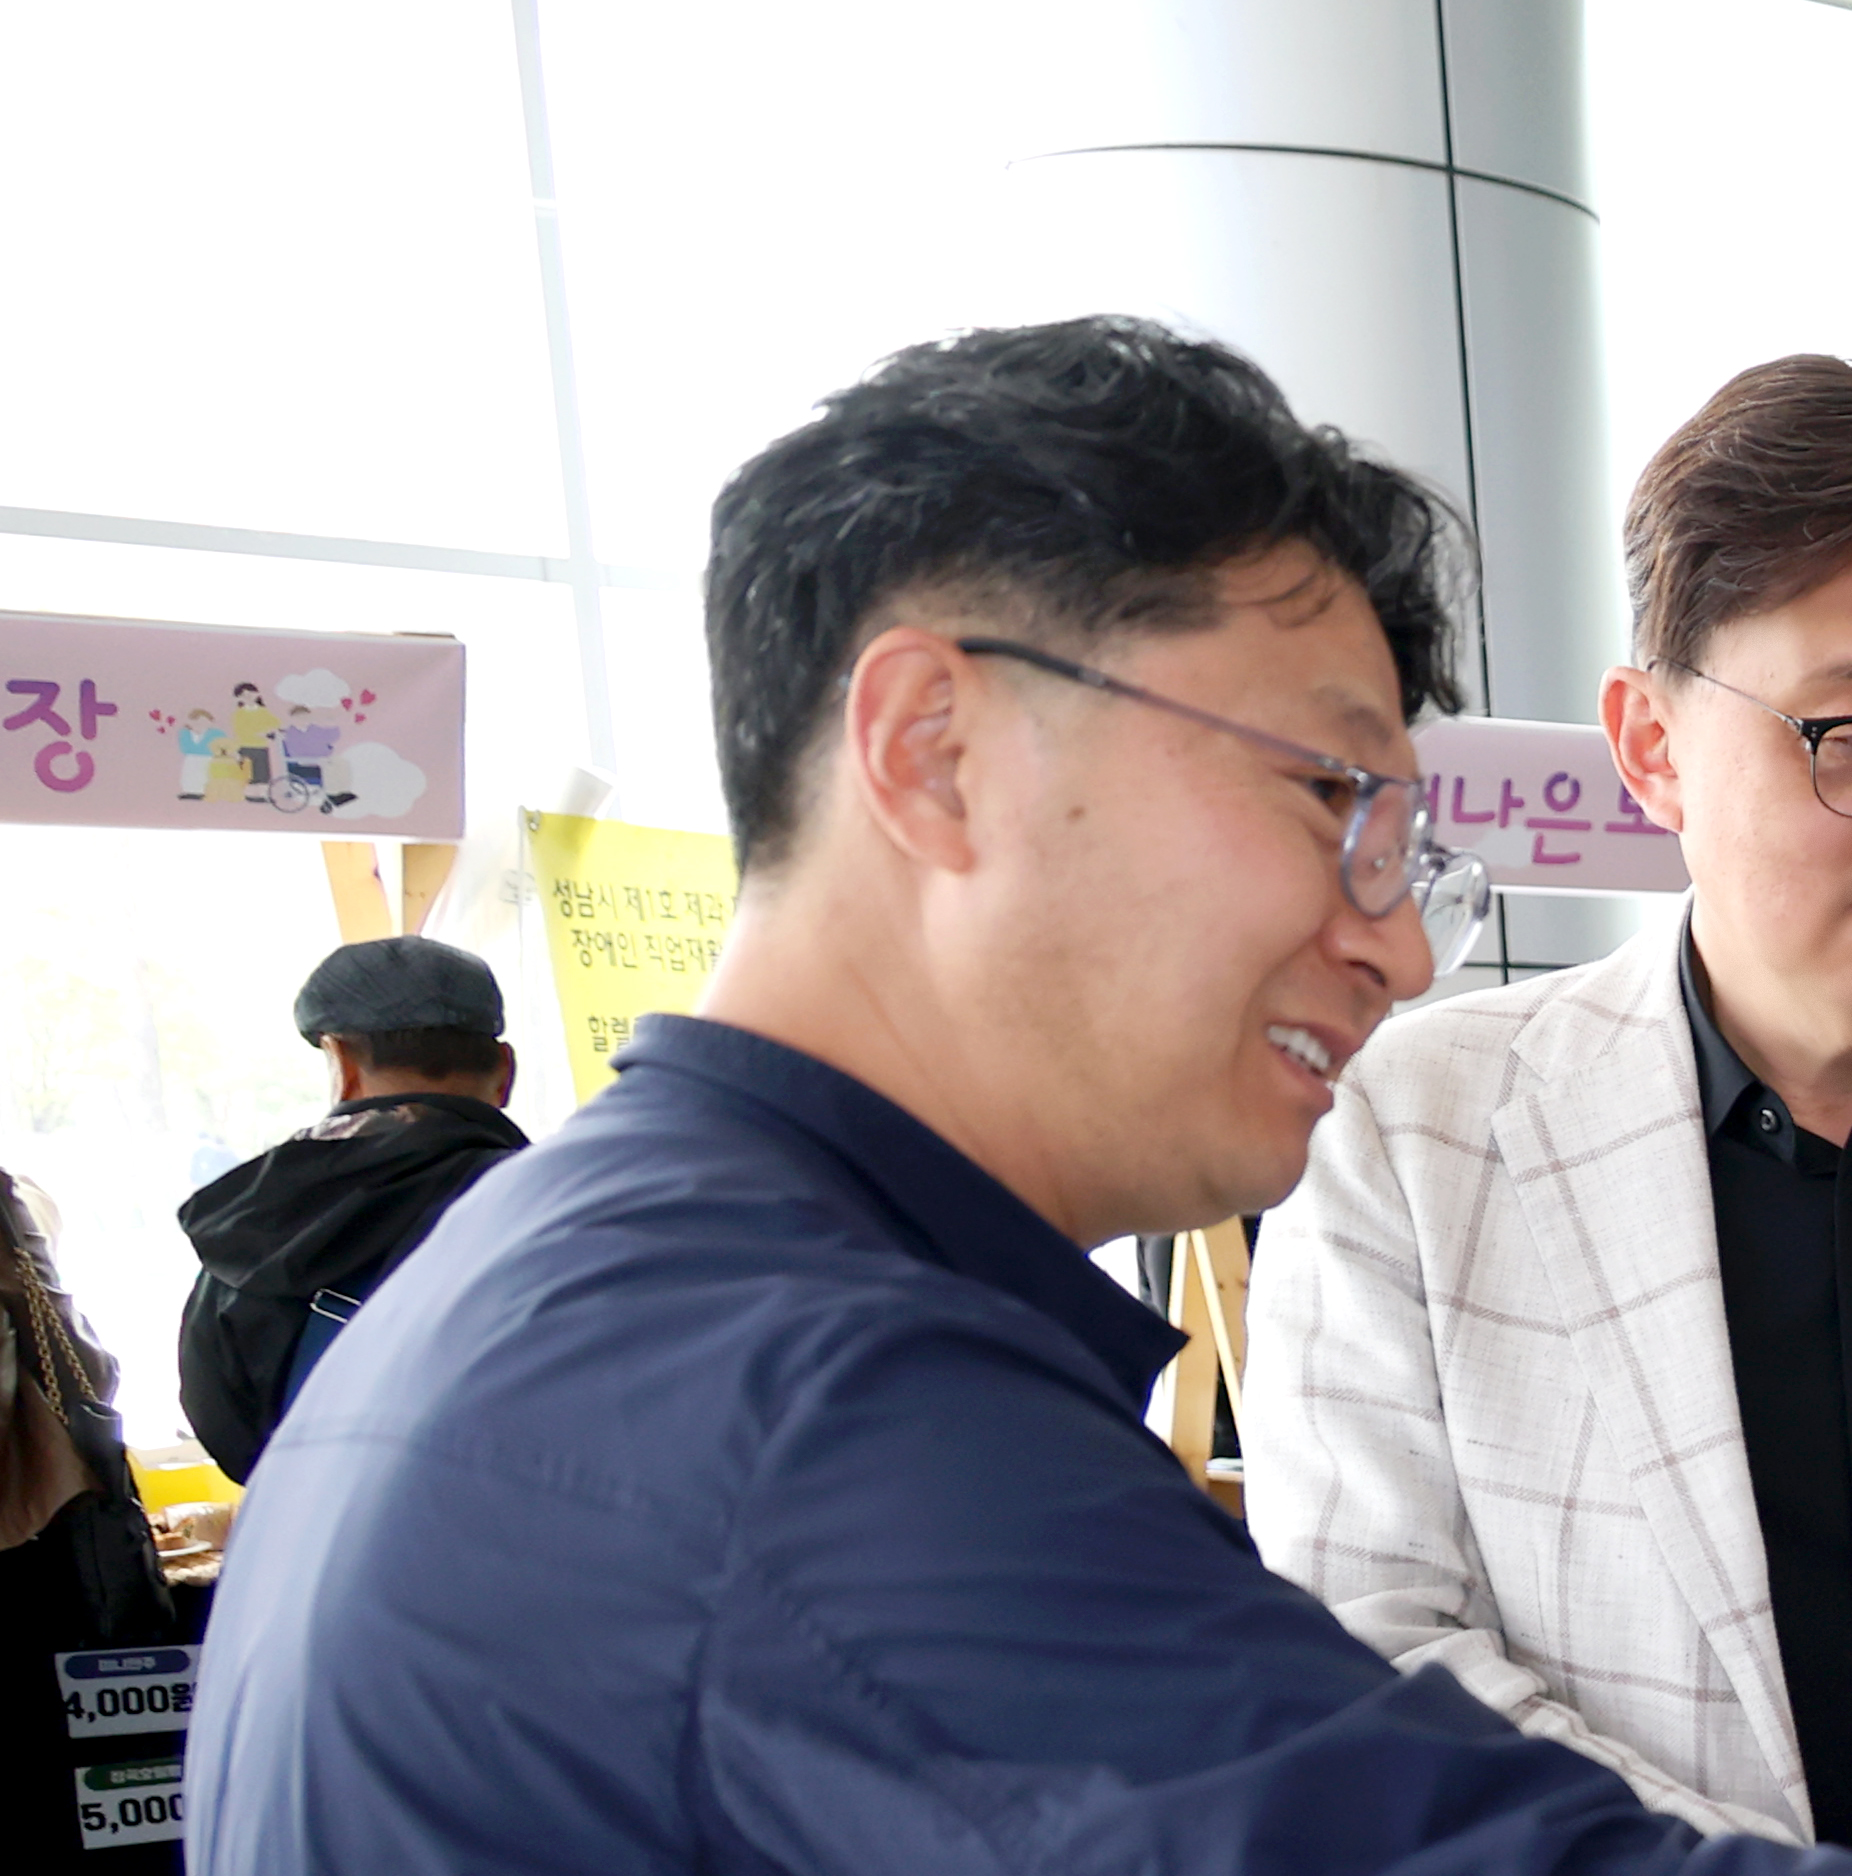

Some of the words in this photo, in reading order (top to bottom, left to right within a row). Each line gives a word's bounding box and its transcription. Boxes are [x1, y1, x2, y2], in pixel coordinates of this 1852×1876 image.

[3, 677, 118, 793] 장
[1426, 770, 1592, 865] 나은
[553, 878, 618, 921] 성남시
[571, 928, 638, 969] 장애인
